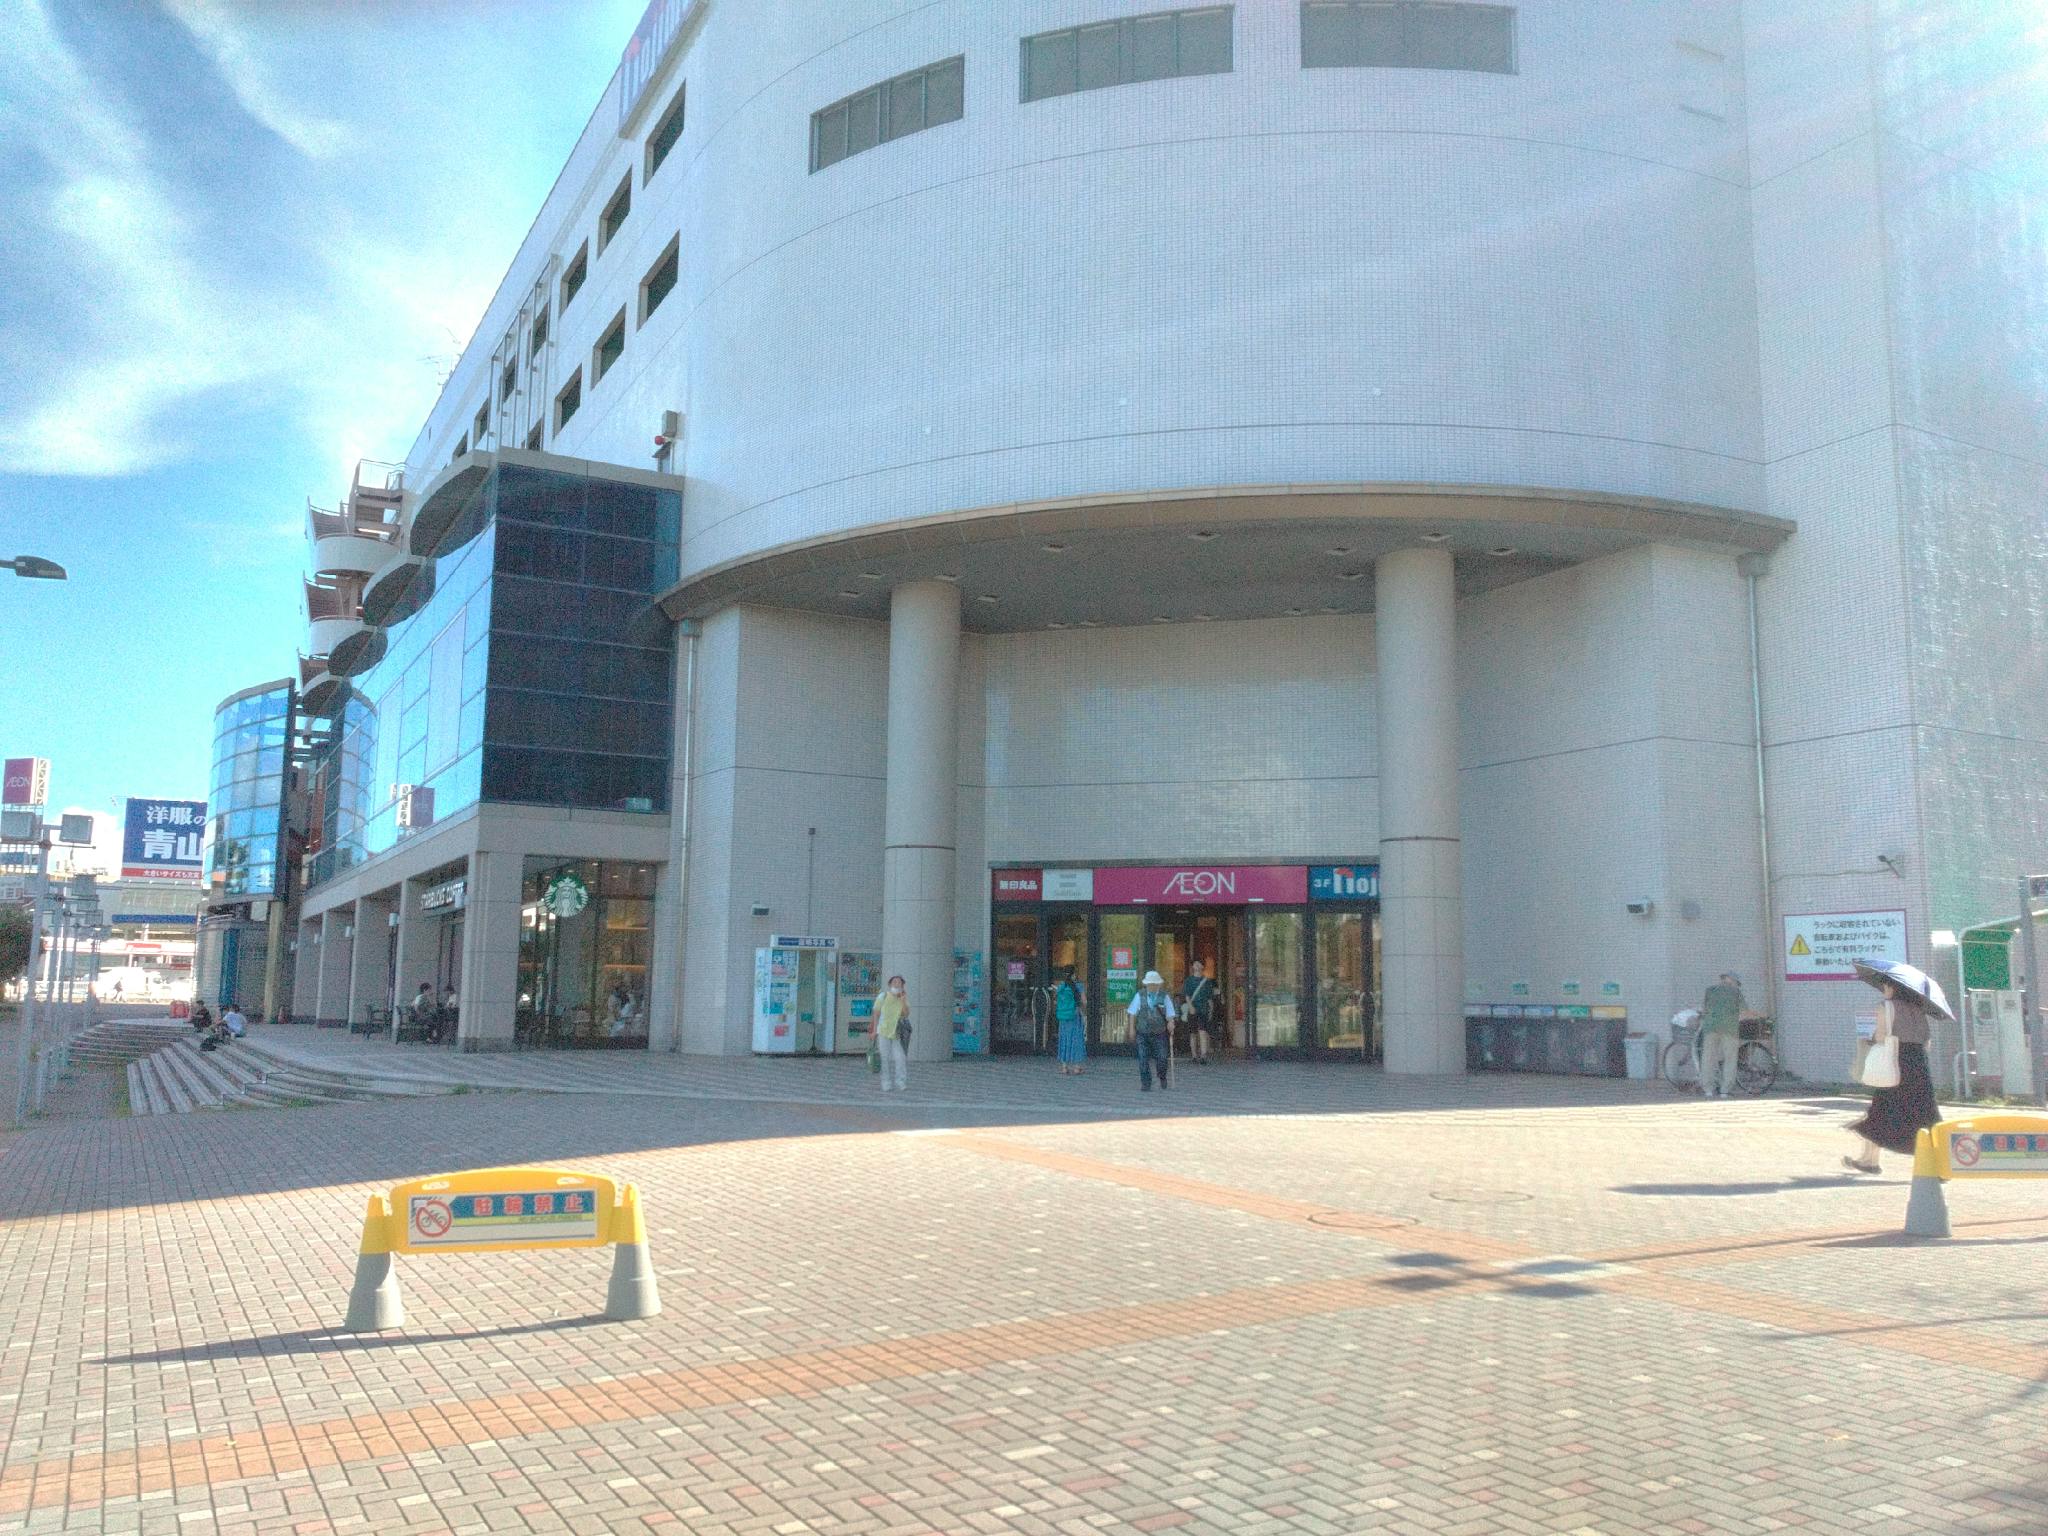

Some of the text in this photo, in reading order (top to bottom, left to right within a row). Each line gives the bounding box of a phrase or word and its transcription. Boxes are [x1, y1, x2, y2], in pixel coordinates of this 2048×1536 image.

[147, 806, 207, 826] 洋服の
[142, 829, 204, 860] 青山
